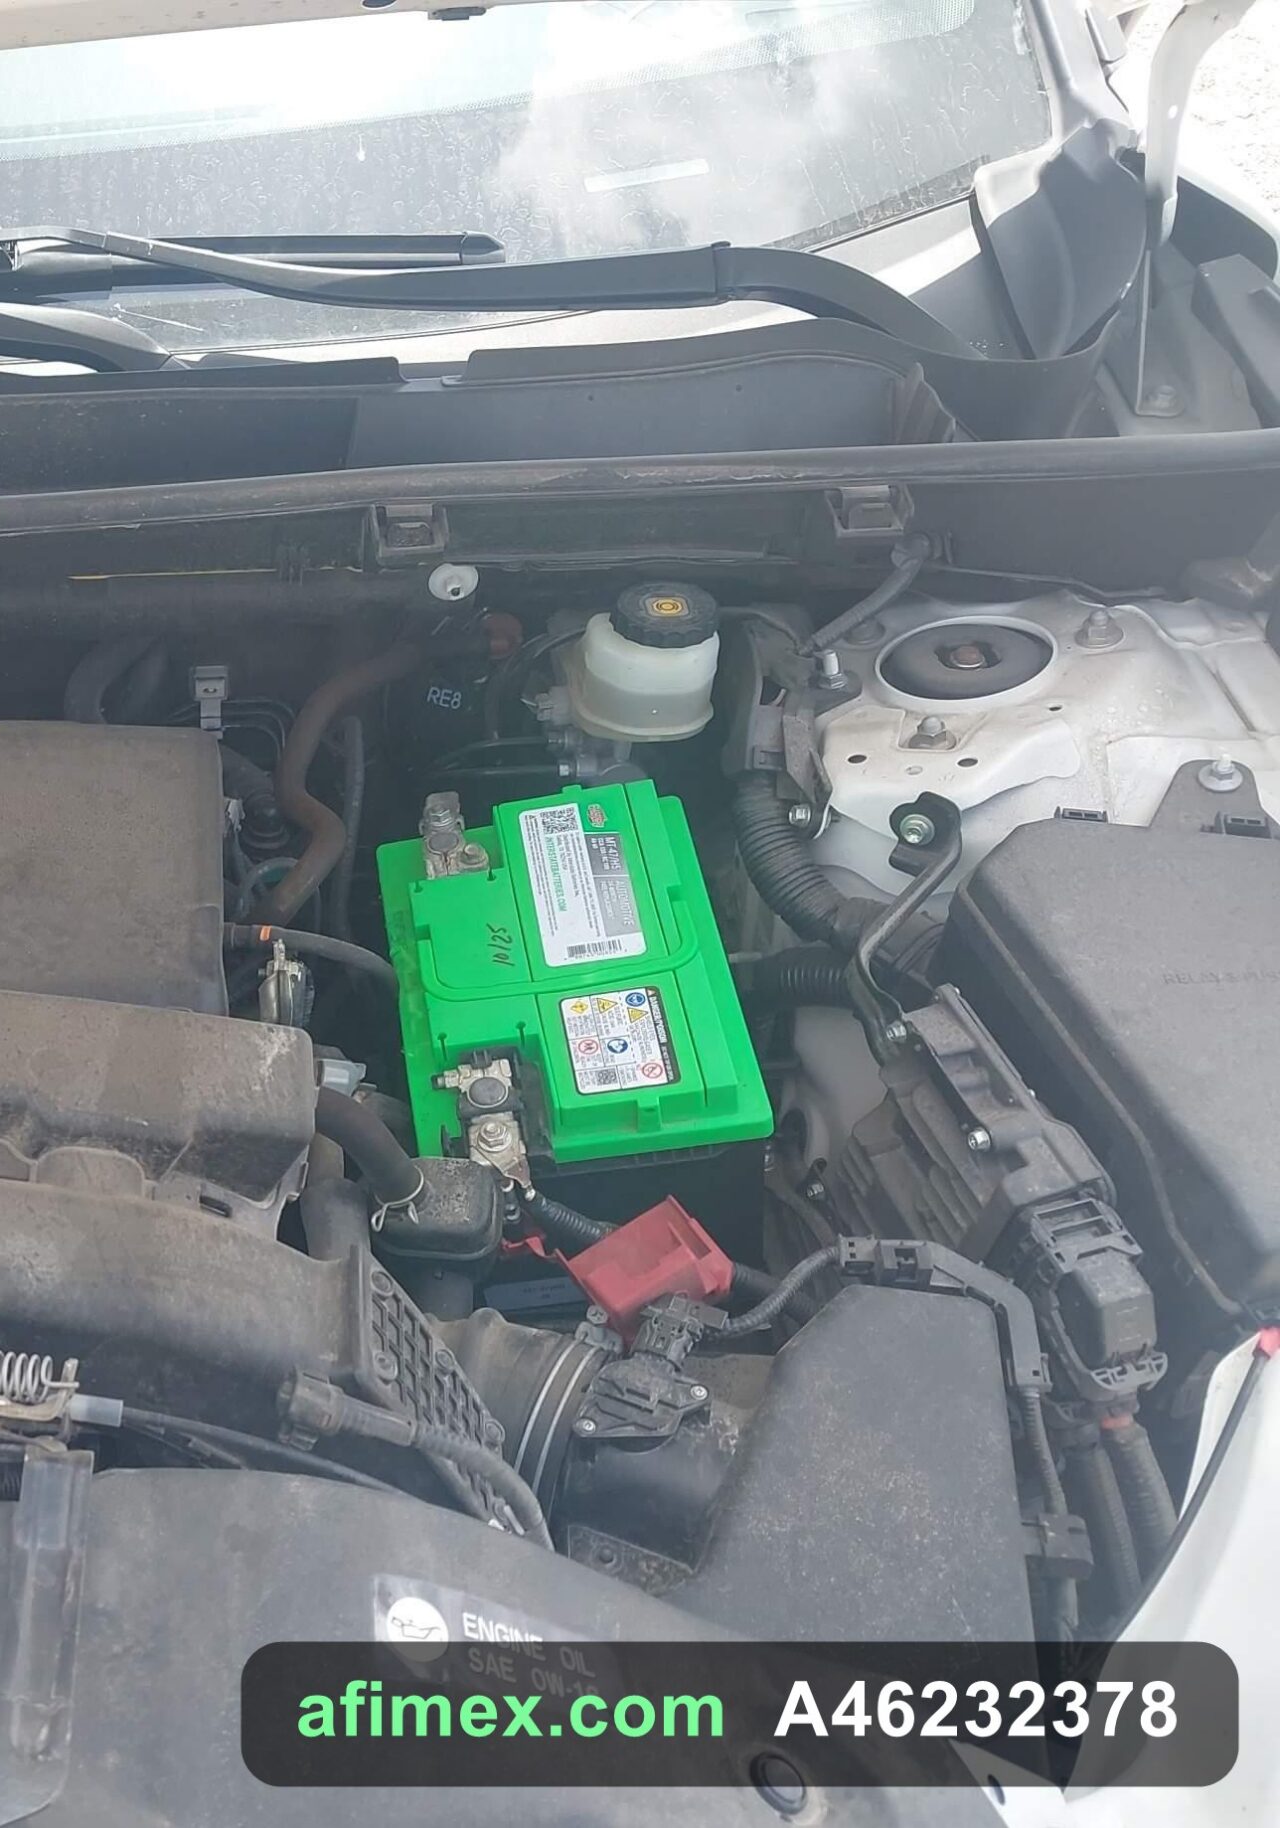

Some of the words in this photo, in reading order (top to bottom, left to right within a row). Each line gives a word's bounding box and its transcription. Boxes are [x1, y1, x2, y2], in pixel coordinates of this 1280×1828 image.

[426, 686, 462, 709] RE8
[545, 836, 567, 912] INTERSTATEBATTERIES.COM
[616, 880, 635, 925] AUTOMOTIVE
[486, 923, 515, 966] 10/25
[1242, 970, 1280, 983] FUS
[462, 1612, 546, 1661] ENGINE
[559, 1645, 596, 1678] OIL
[469, 1647, 517, 1683] SAE
